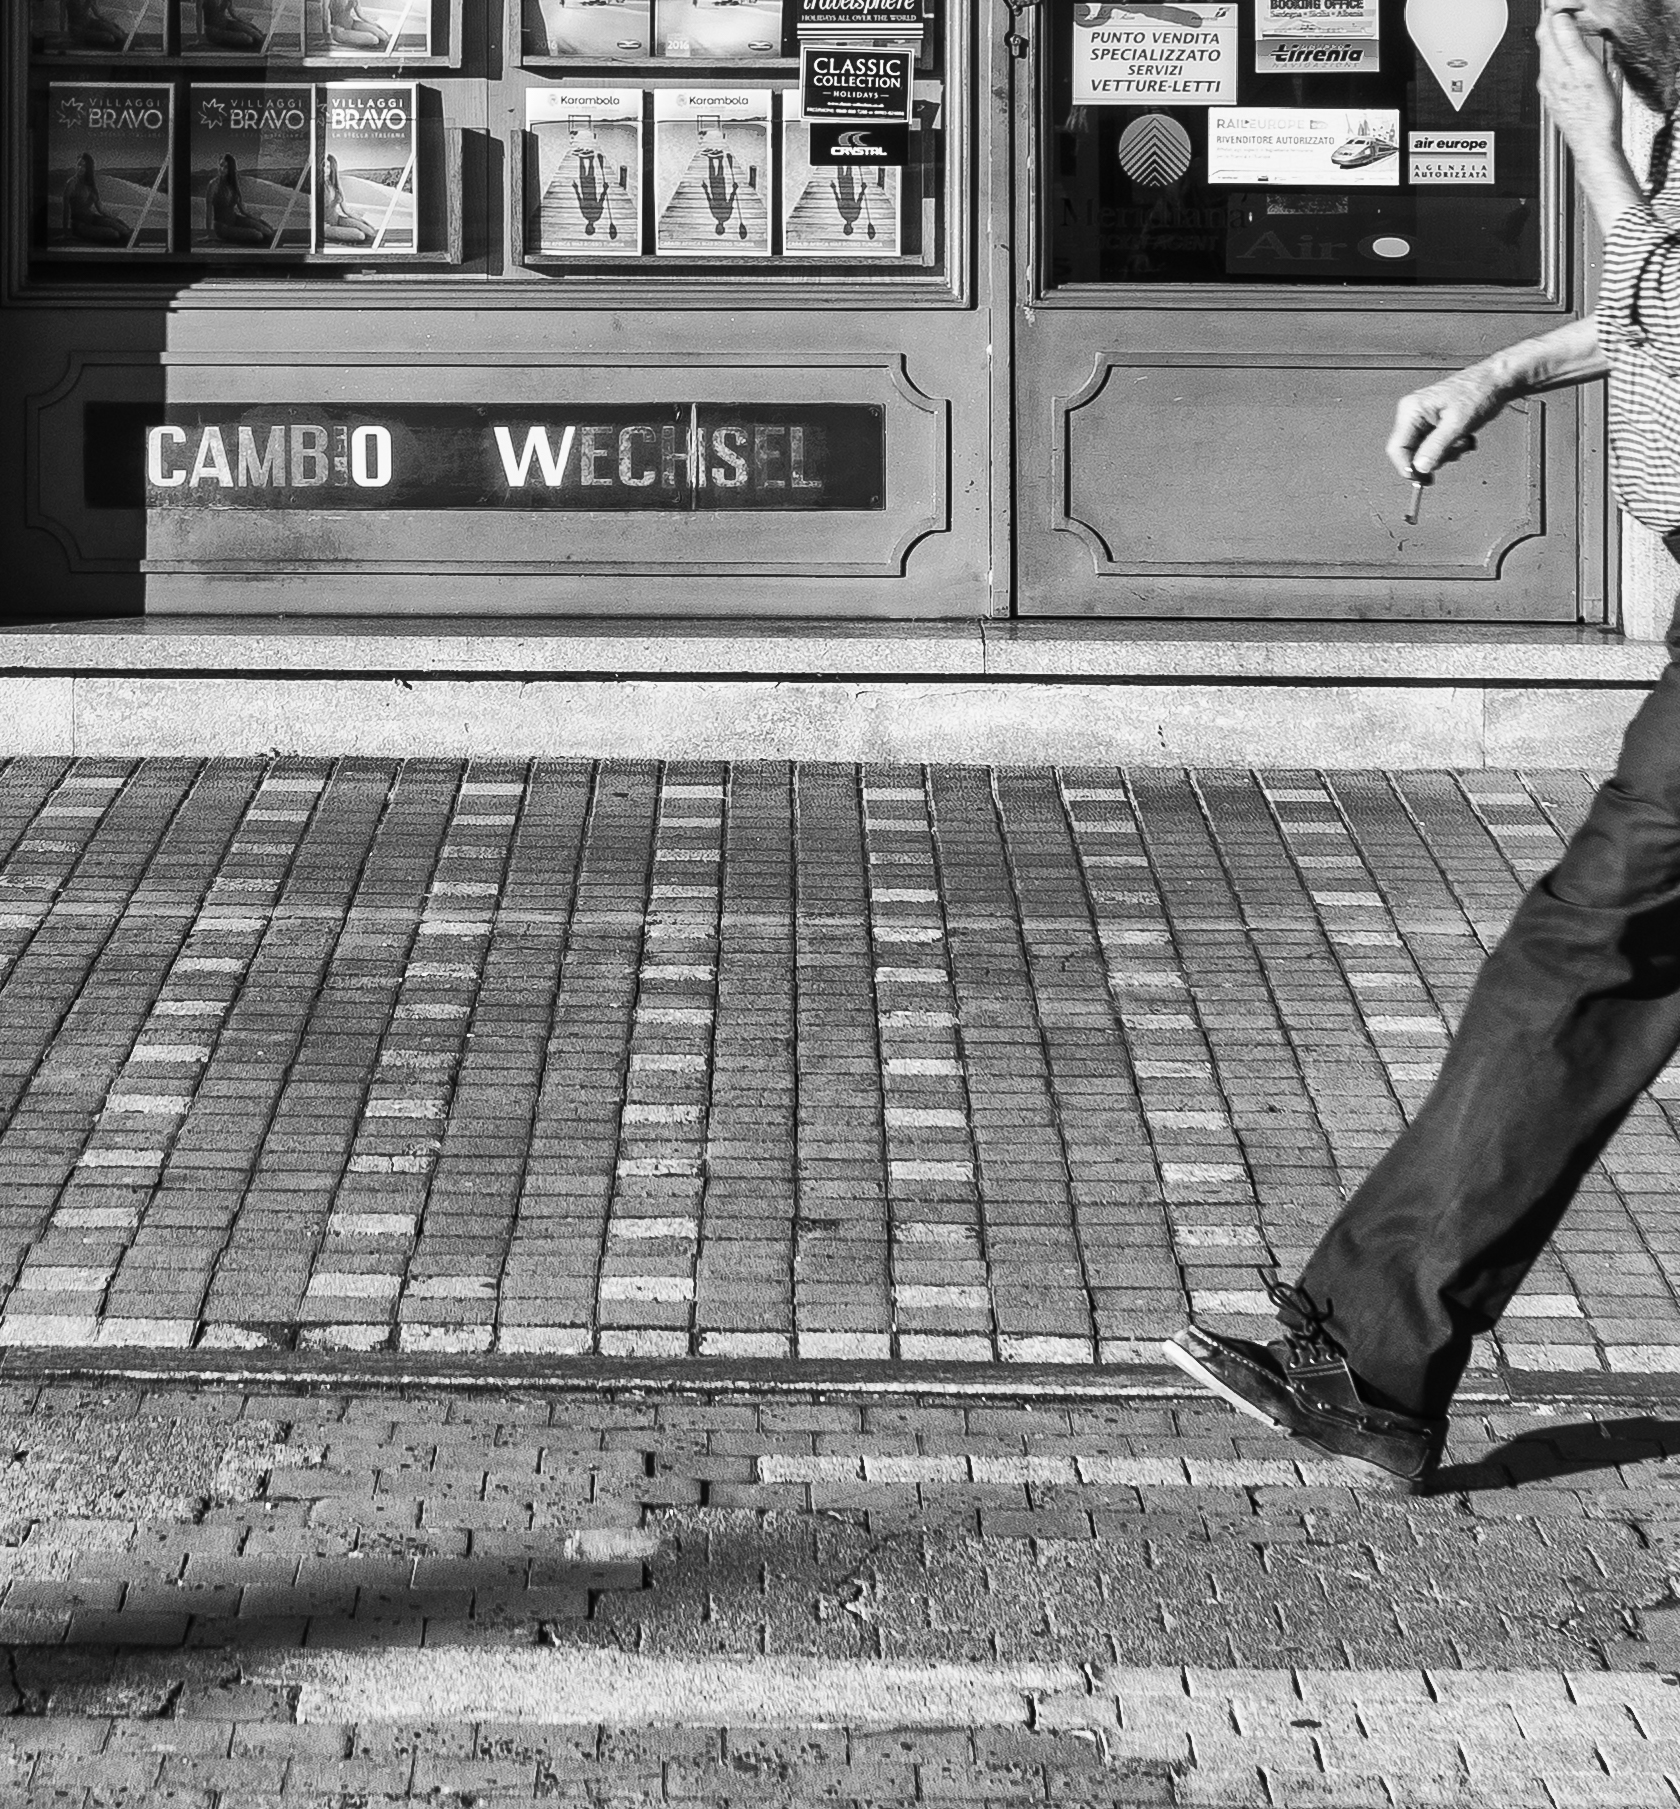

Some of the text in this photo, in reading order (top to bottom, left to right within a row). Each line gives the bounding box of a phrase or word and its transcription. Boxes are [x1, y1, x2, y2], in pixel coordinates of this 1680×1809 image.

[1091, 32, 1220, 44] PUNTO VENDITA
[667, 38, 690, 51] 2016
[1090, 48, 1221, 62] SPECIALIZZATO
[1269, 43, 1364, 63] tirrenia
[813, 57, 901, 76] CLASSIC
[1127, 64, 1184, 76] SERVIZI
[813, 75, 901, 89] COLLECTION
[1090, 79, 1221, 93] VETTURE-LETTI
[560, 95, 620, 106] Karambola
[689, 95, 749, 106] Karambola
[833, 90, 879, 99] HOLIDAYS
[88, 98, 162, 109] VILLAGGI
[230, 98, 302, 109] VILLAGGI
[332, 98, 404, 109] VILLAGGI
[88, 109, 163, 129] BRAVO
[230, 109, 304, 129] BRAVO
[332, 108, 406, 130] BRAVO
[1216, 136, 1335, 146] RIVENDITORE AUTORIZZATO
[1414, 138, 1488, 151] air europe
[830, 147, 888, 156] CRYSTAL
[1414, 164, 1488, 172] AGENZIA
[1414, 171, 1488, 179] AUTORIZZATA
[146, 424, 824, 491] CAMBIO WECHSEL
